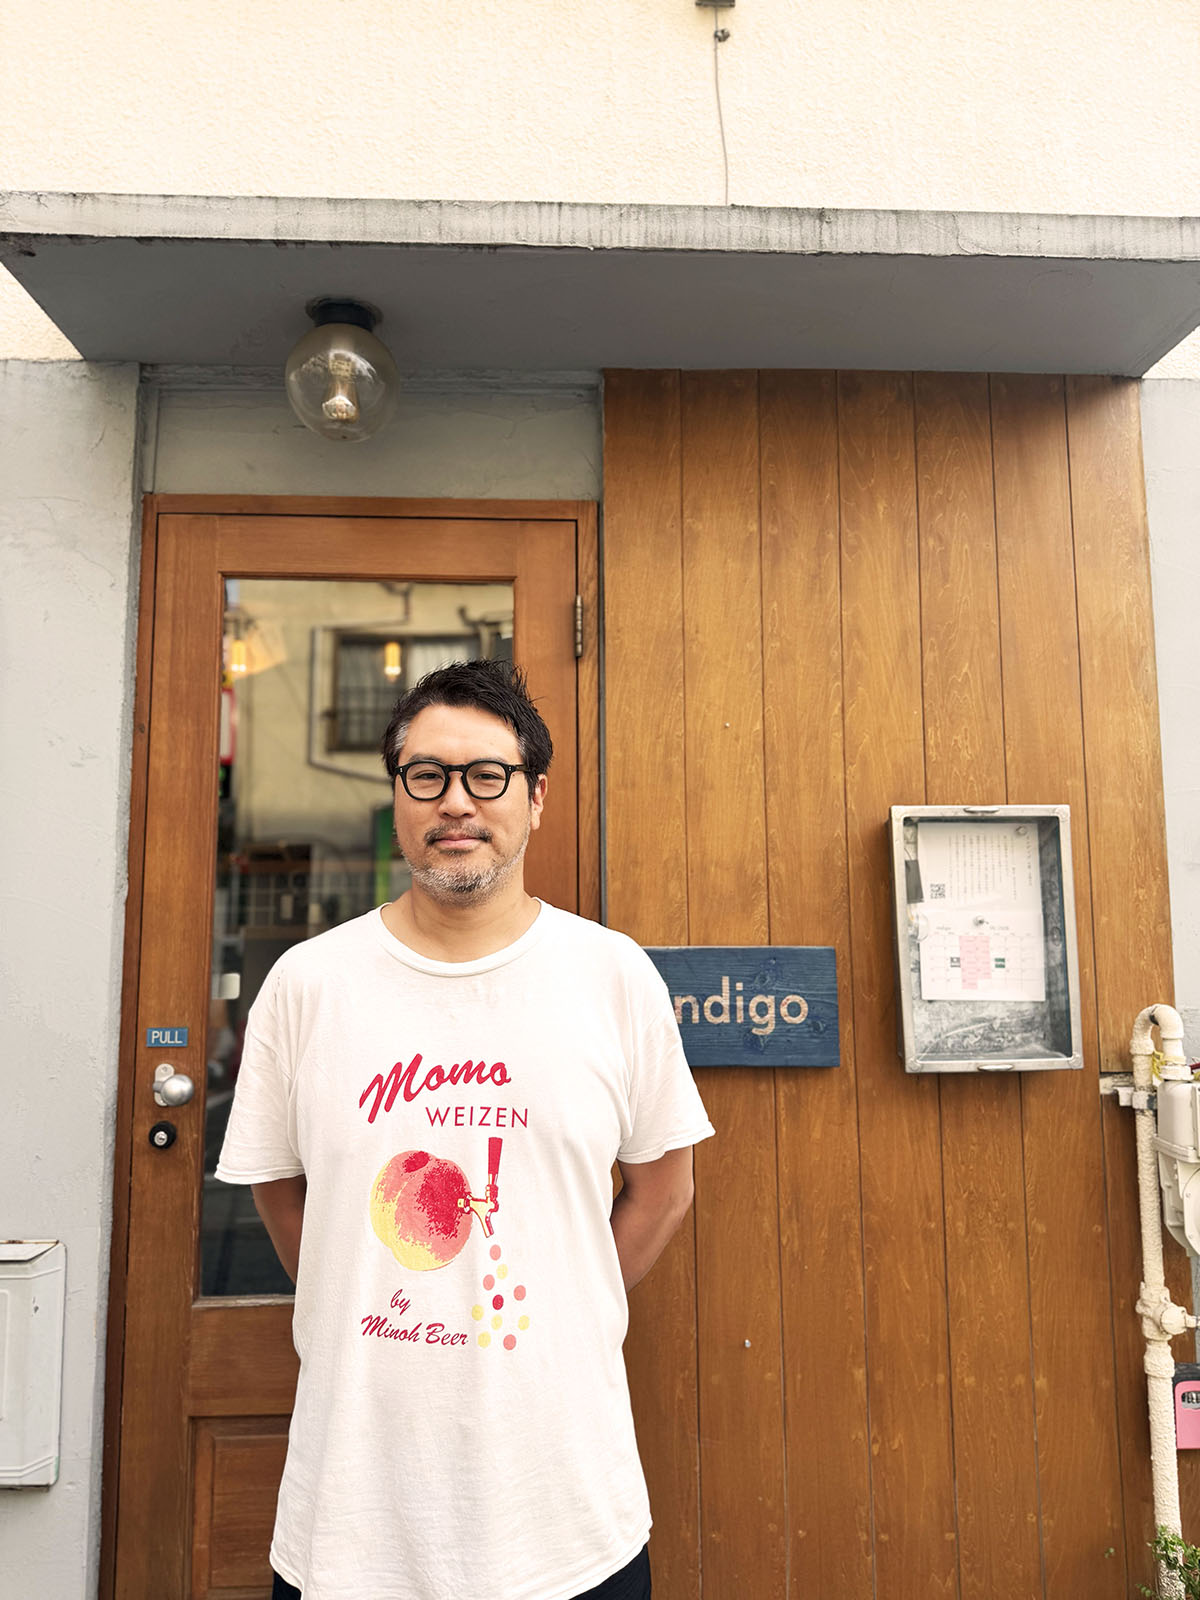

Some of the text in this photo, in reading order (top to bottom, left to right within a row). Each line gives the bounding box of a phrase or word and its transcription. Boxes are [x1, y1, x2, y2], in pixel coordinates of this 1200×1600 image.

[673, 976, 809, 1035] ndigo
[151, 1030, 184, 1044] PULL
[359, 1053, 512, 1124] Momo
[425, 1106, 528, 1128] WEIZEN
[389, 1288, 412, 1316] by
[361, 1314, 469, 1346] Minoh Beer
